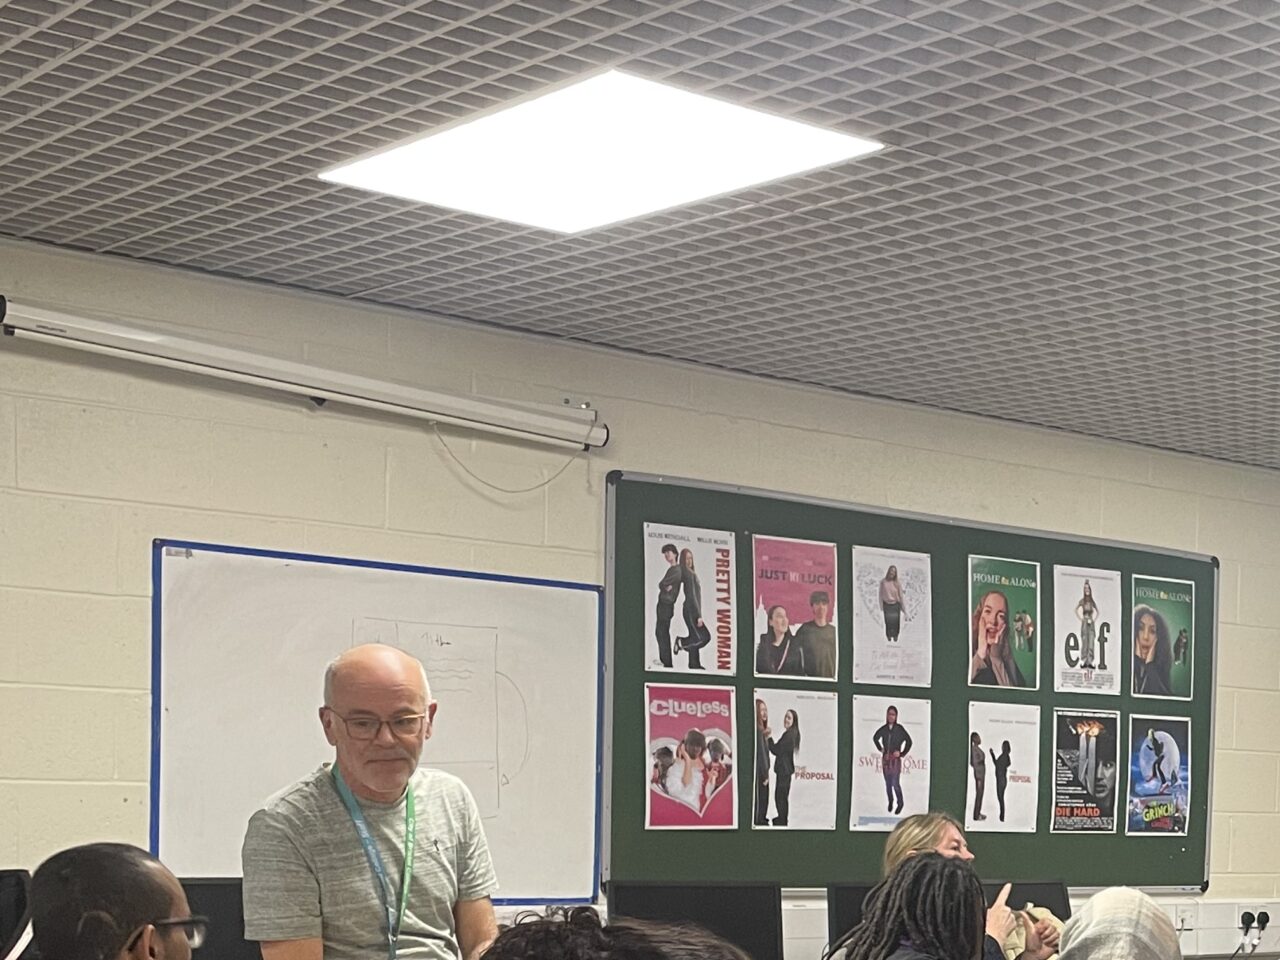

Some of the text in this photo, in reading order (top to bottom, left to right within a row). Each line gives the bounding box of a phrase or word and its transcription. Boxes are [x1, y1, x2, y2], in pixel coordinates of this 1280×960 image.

[759, 569, 788, 581] JUST
[801, 573, 833, 586] LUCK
[973, 573, 1000, 585] HOME
[715, 548, 731, 670] PRETTY WOMAN
[795, 771, 835, 781] PROPOSAL
[1055, 807, 1100, 817] DIE HARD
[1142, 803, 1176, 822] GRINCH
